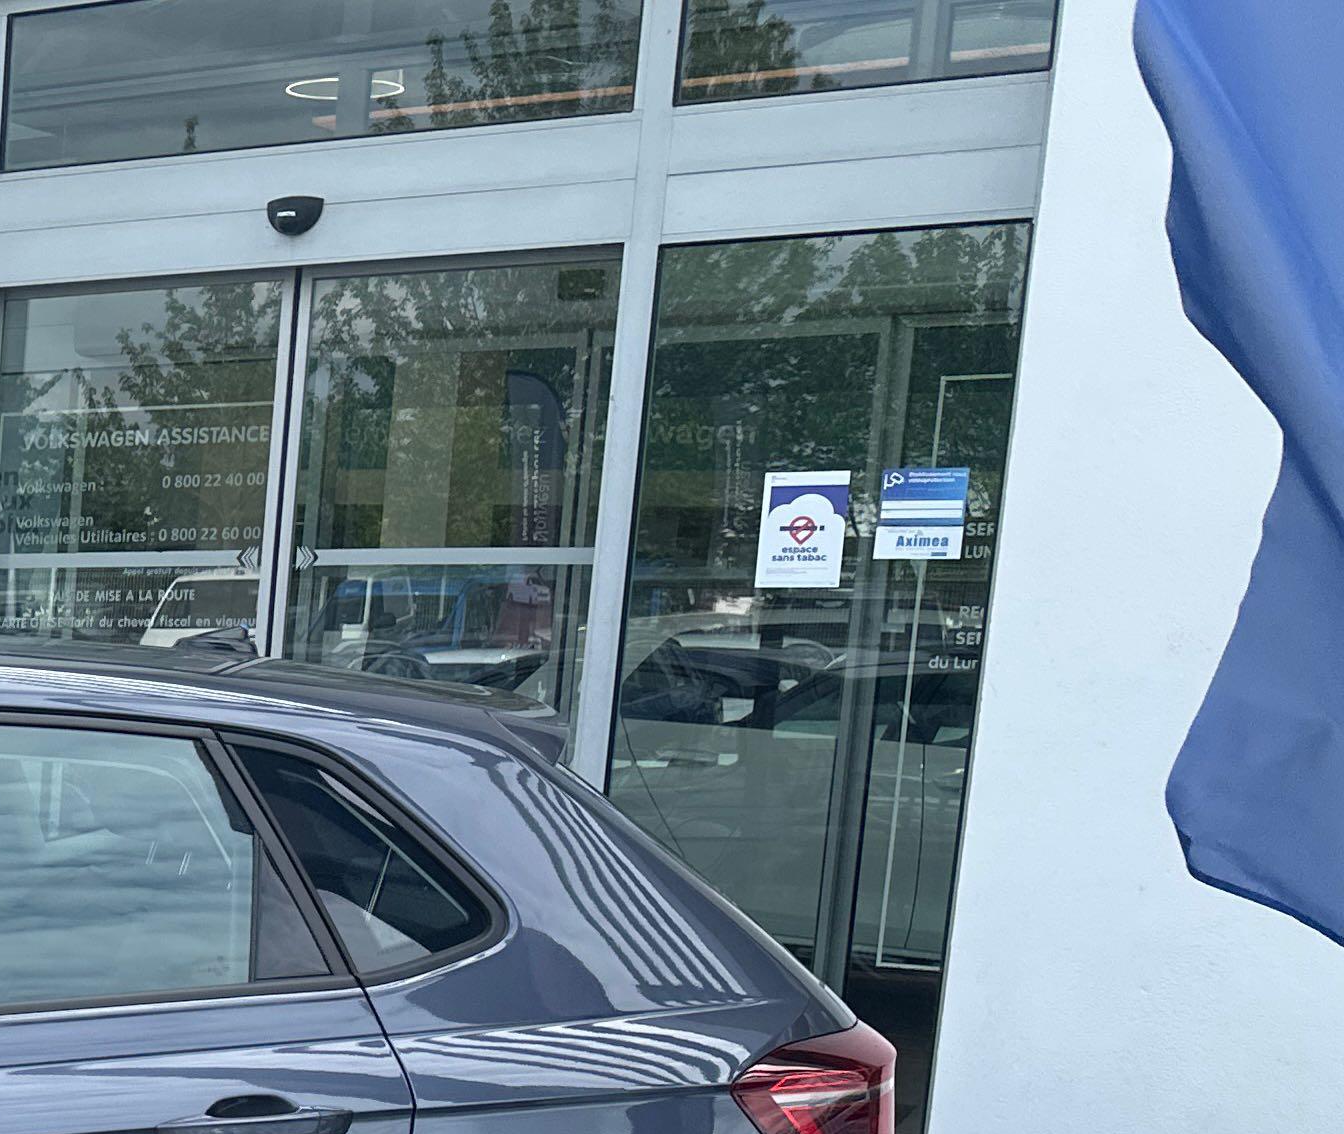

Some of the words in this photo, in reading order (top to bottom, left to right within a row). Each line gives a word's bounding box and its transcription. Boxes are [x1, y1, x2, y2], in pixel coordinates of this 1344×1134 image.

[23, 429, 149, 450] VOLKSWAGEN
[157, 425, 269, 446] ASSISTANCE
[18, 479, 96, 495] Volkswagen
[162, 477, 170, 489] 0
[175, 475, 200, 488] 800
[204, 474, 221, 487] 22
[225, 473, 242, 486] 40
[247, 472, 264, 486] 00
[15, 515, 94, 529] Volkswagen
[14, 530, 76, 546] Véhicules
[81, 529, 147, 543] Utilitaires
[158, 529, 167, 541] 0
[171, 528, 196, 541] 800
[200, 528, 218, 541] 22
[222, 527, 239, 540] 60
[243, 526, 261, 539] 00
[896, 534, 949, 547] Aximea
[95, 590, 121, 602] MISE
[139, 589, 153, 601] LA
[158, 588, 196, 601] ROUTE
[100, 615, 113, 627] du
[159, 613, 191, 627] fiscal
[196, 617, 211, 627] en
[216, 614, 256, 630] vigueu
[928, 656, 949, 669] du
